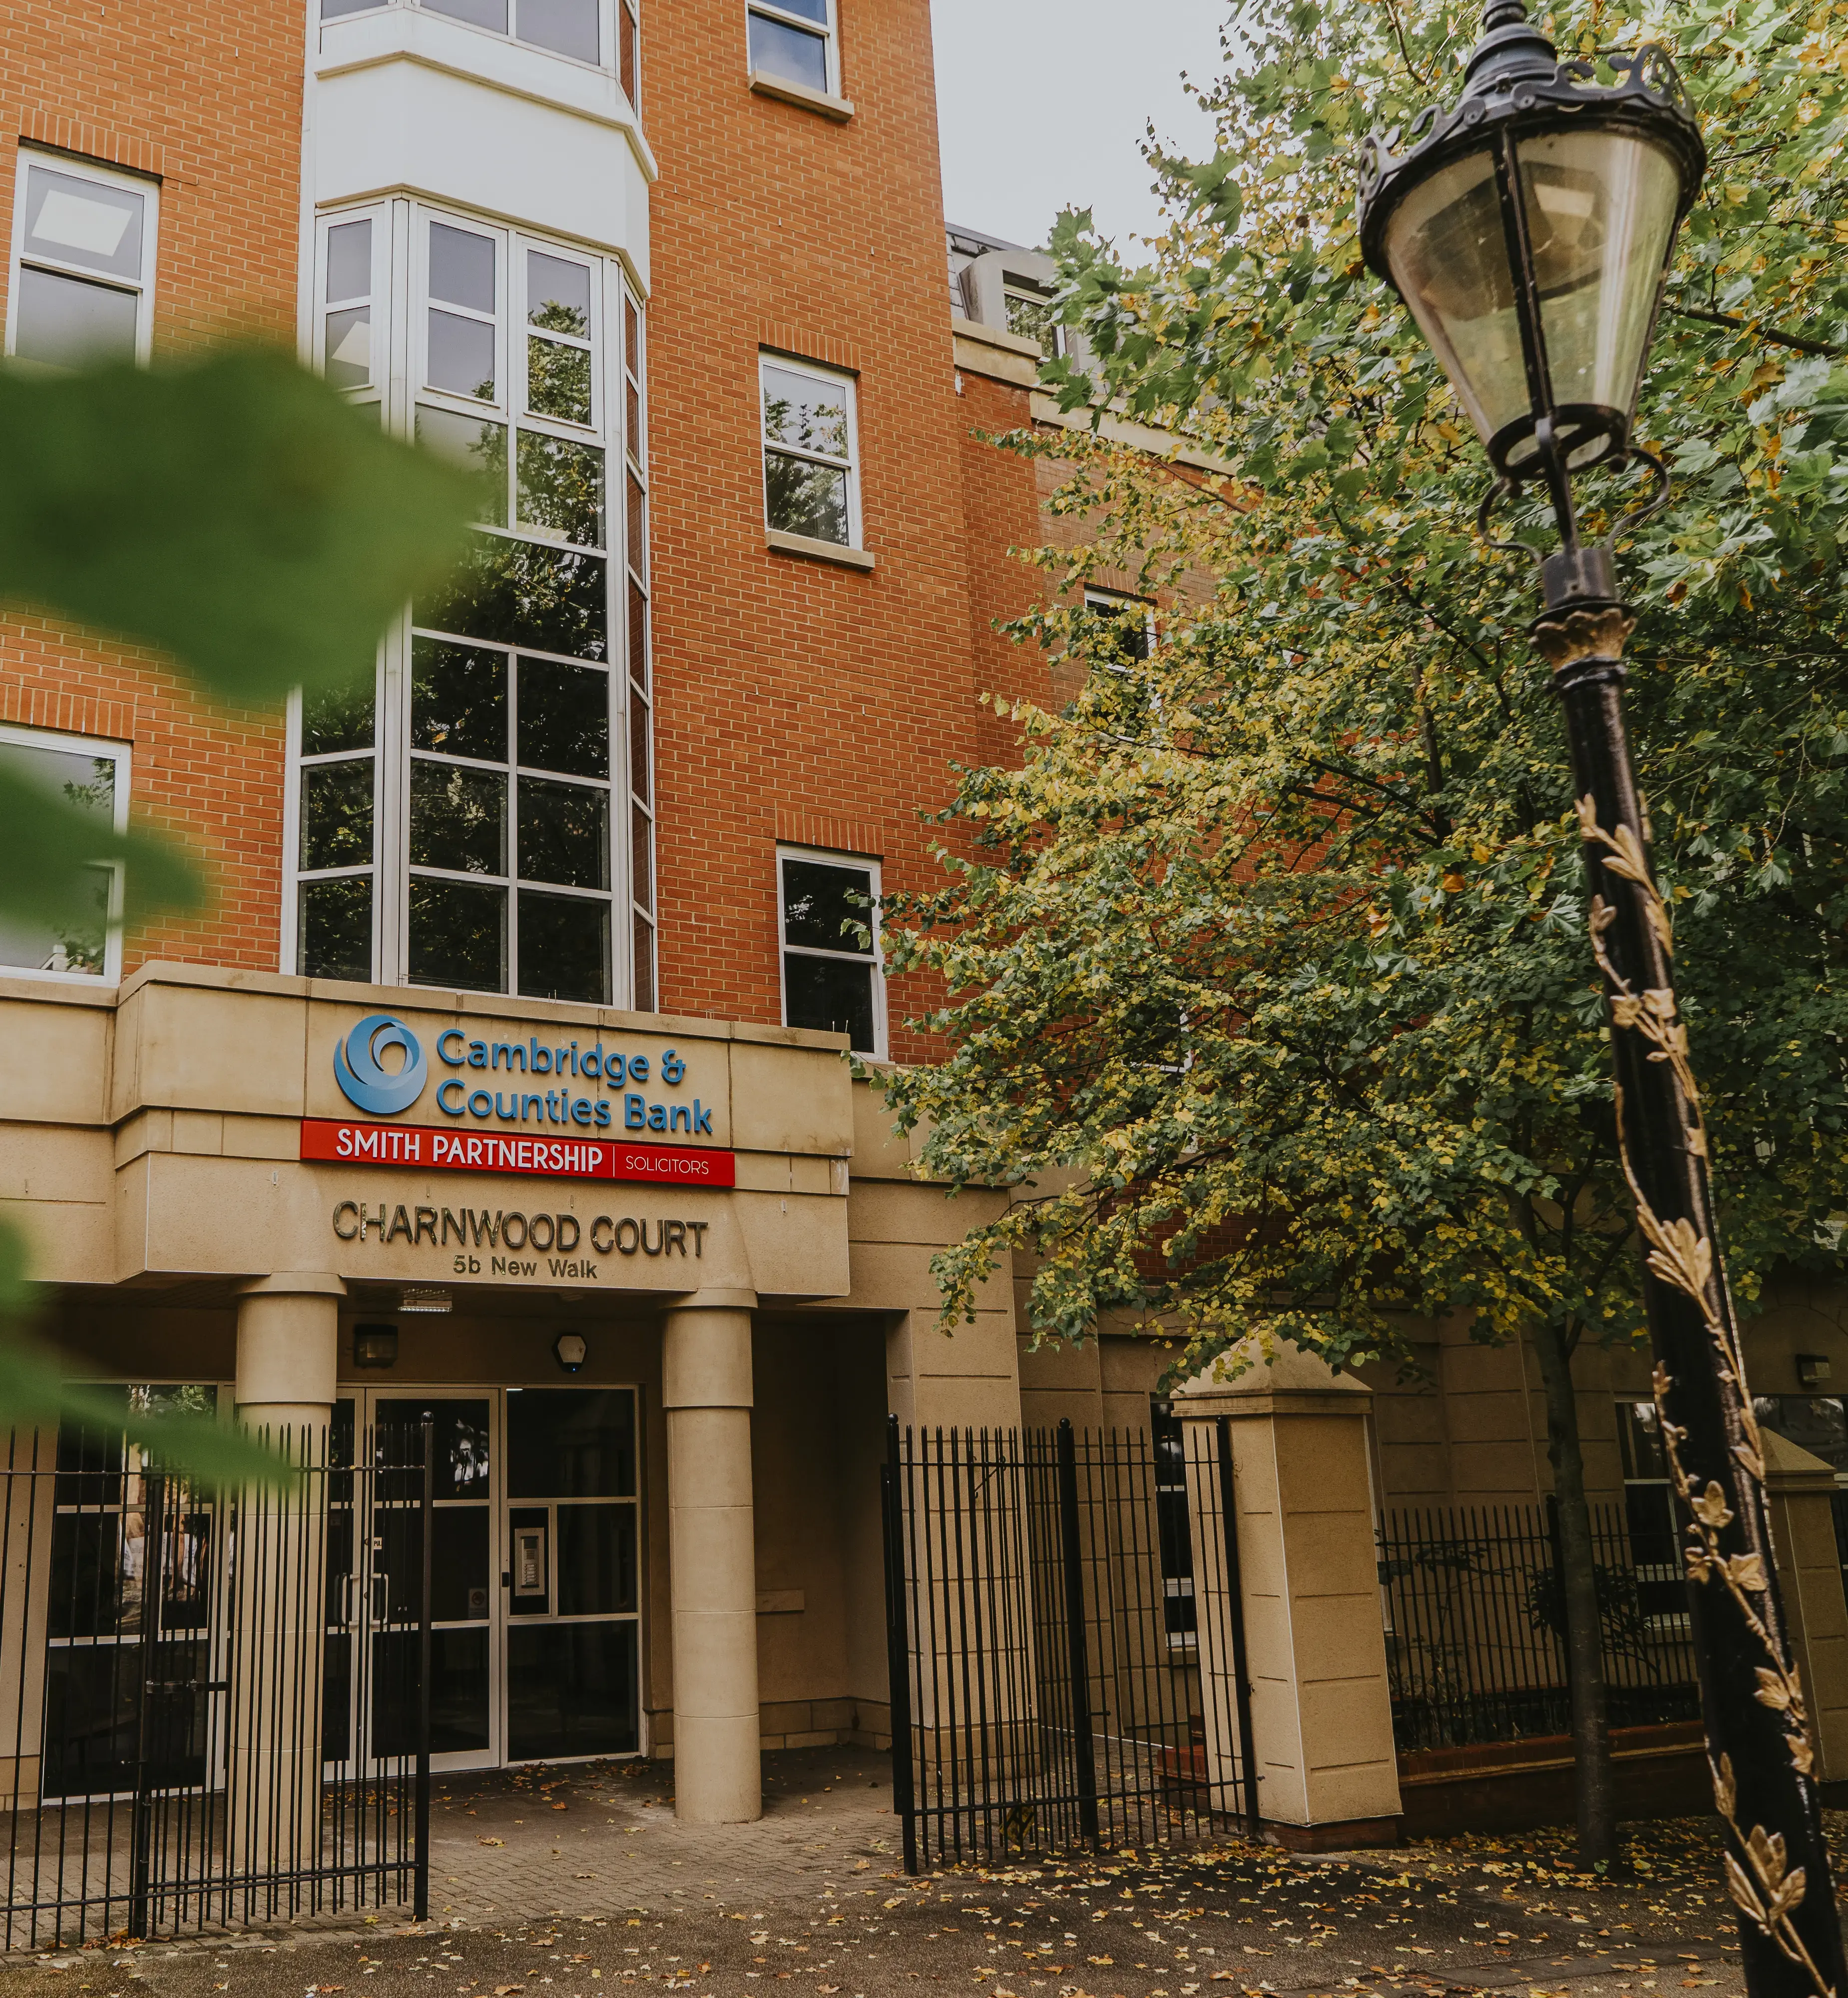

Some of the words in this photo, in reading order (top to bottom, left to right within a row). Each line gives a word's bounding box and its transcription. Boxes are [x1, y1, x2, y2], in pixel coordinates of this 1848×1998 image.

[436, 1028, 649, 1087] Cambridge
[661, 1049, 686, 1083] &
[436, 1078, 612, 1126] Counties
[624, 1093, 713, 1133] Bank
[336, 1128, 420, 1161] SMITH
[433, 1135, 603, 1172] PARTNERSHIP
[626, 1155, 709, 1175] SOLICITORS
[333, 1200, 580, 1251] CHARNWOOD
[590, 1215, 709, 1256] COURT
[453, 1255, 481, 1274] 5b
[491, 1256, 537, 1276] New
[547, 1258, 598, 1279] Walk
